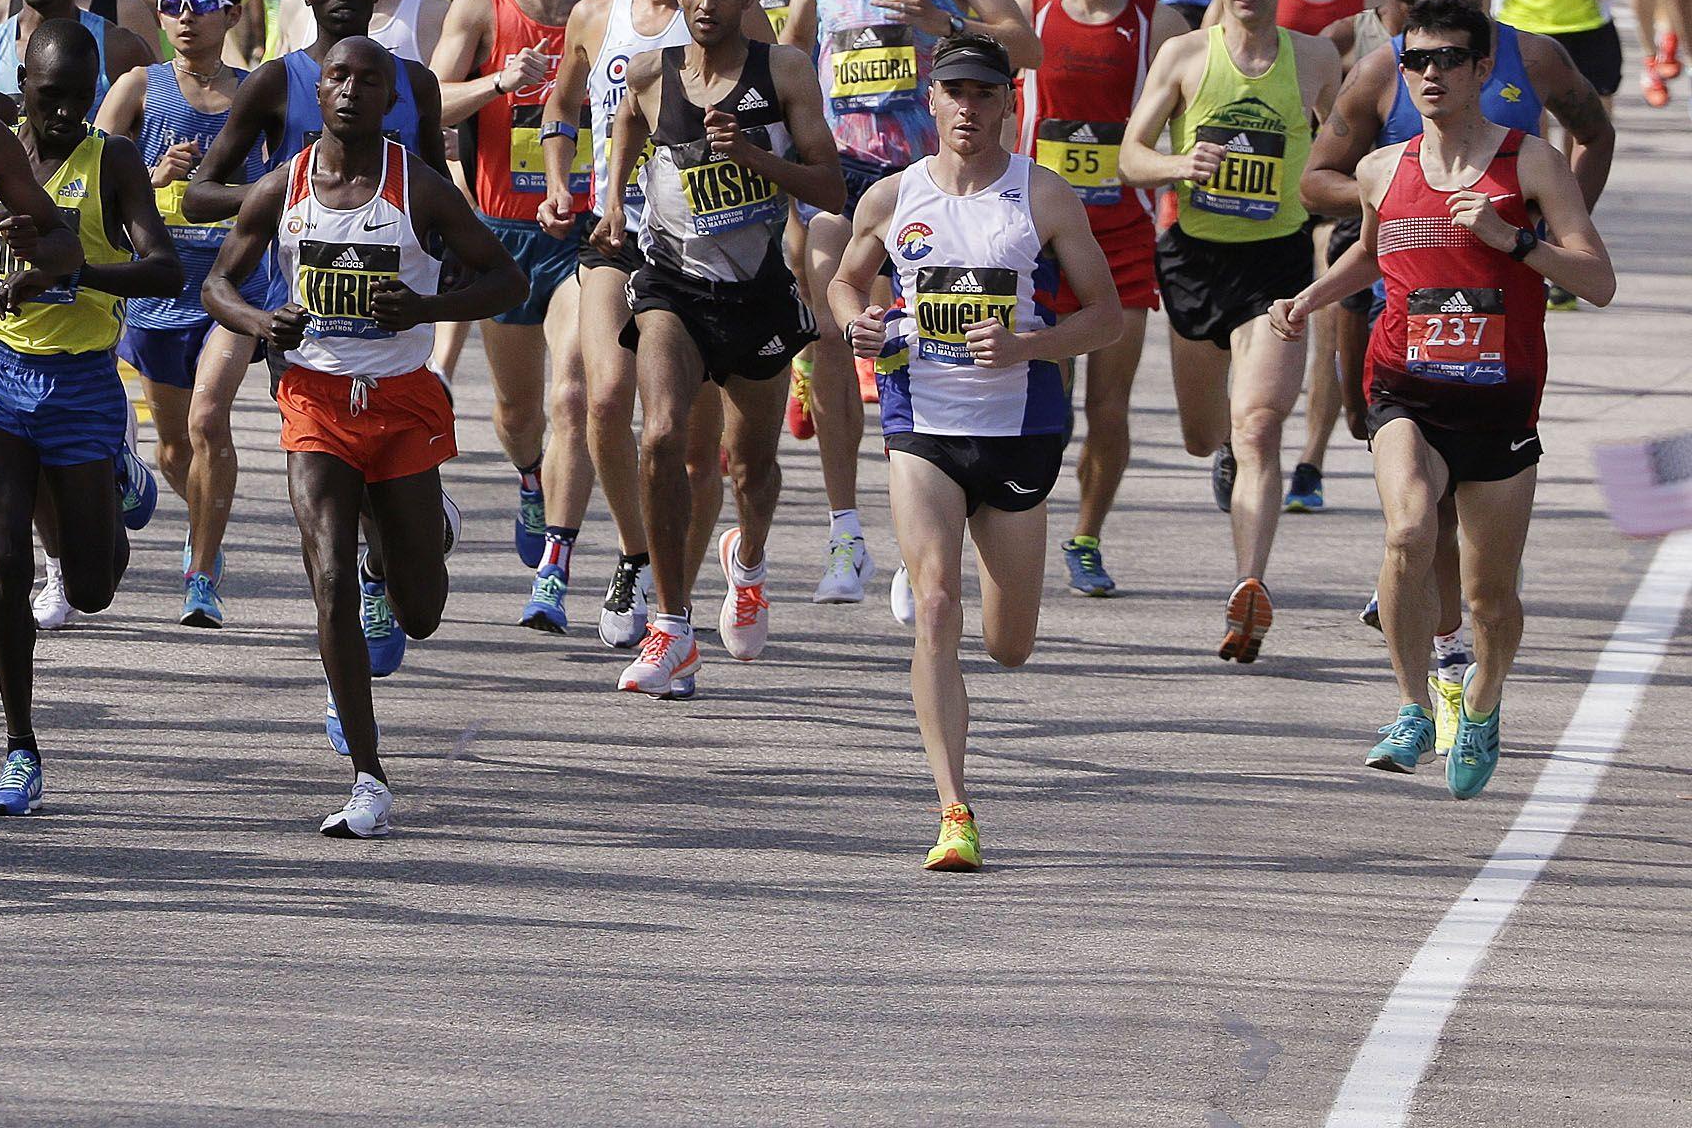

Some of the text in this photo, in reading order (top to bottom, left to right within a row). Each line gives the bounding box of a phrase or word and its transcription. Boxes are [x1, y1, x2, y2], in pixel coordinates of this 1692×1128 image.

[737, 99, 769, 112] adidas
[1065, 149, 1099, 174] 55
[305, 222, 317, 230] NN
[332, 260, 364, 269] adidas
[306, 270, 390, 318] KIRU
[951, 284, 983, 293] adidas
[1440, 305, 1473, 313] adidas
[1426, 317, 1488, 346] 237
[1409, 347, 1416, 358] 1
